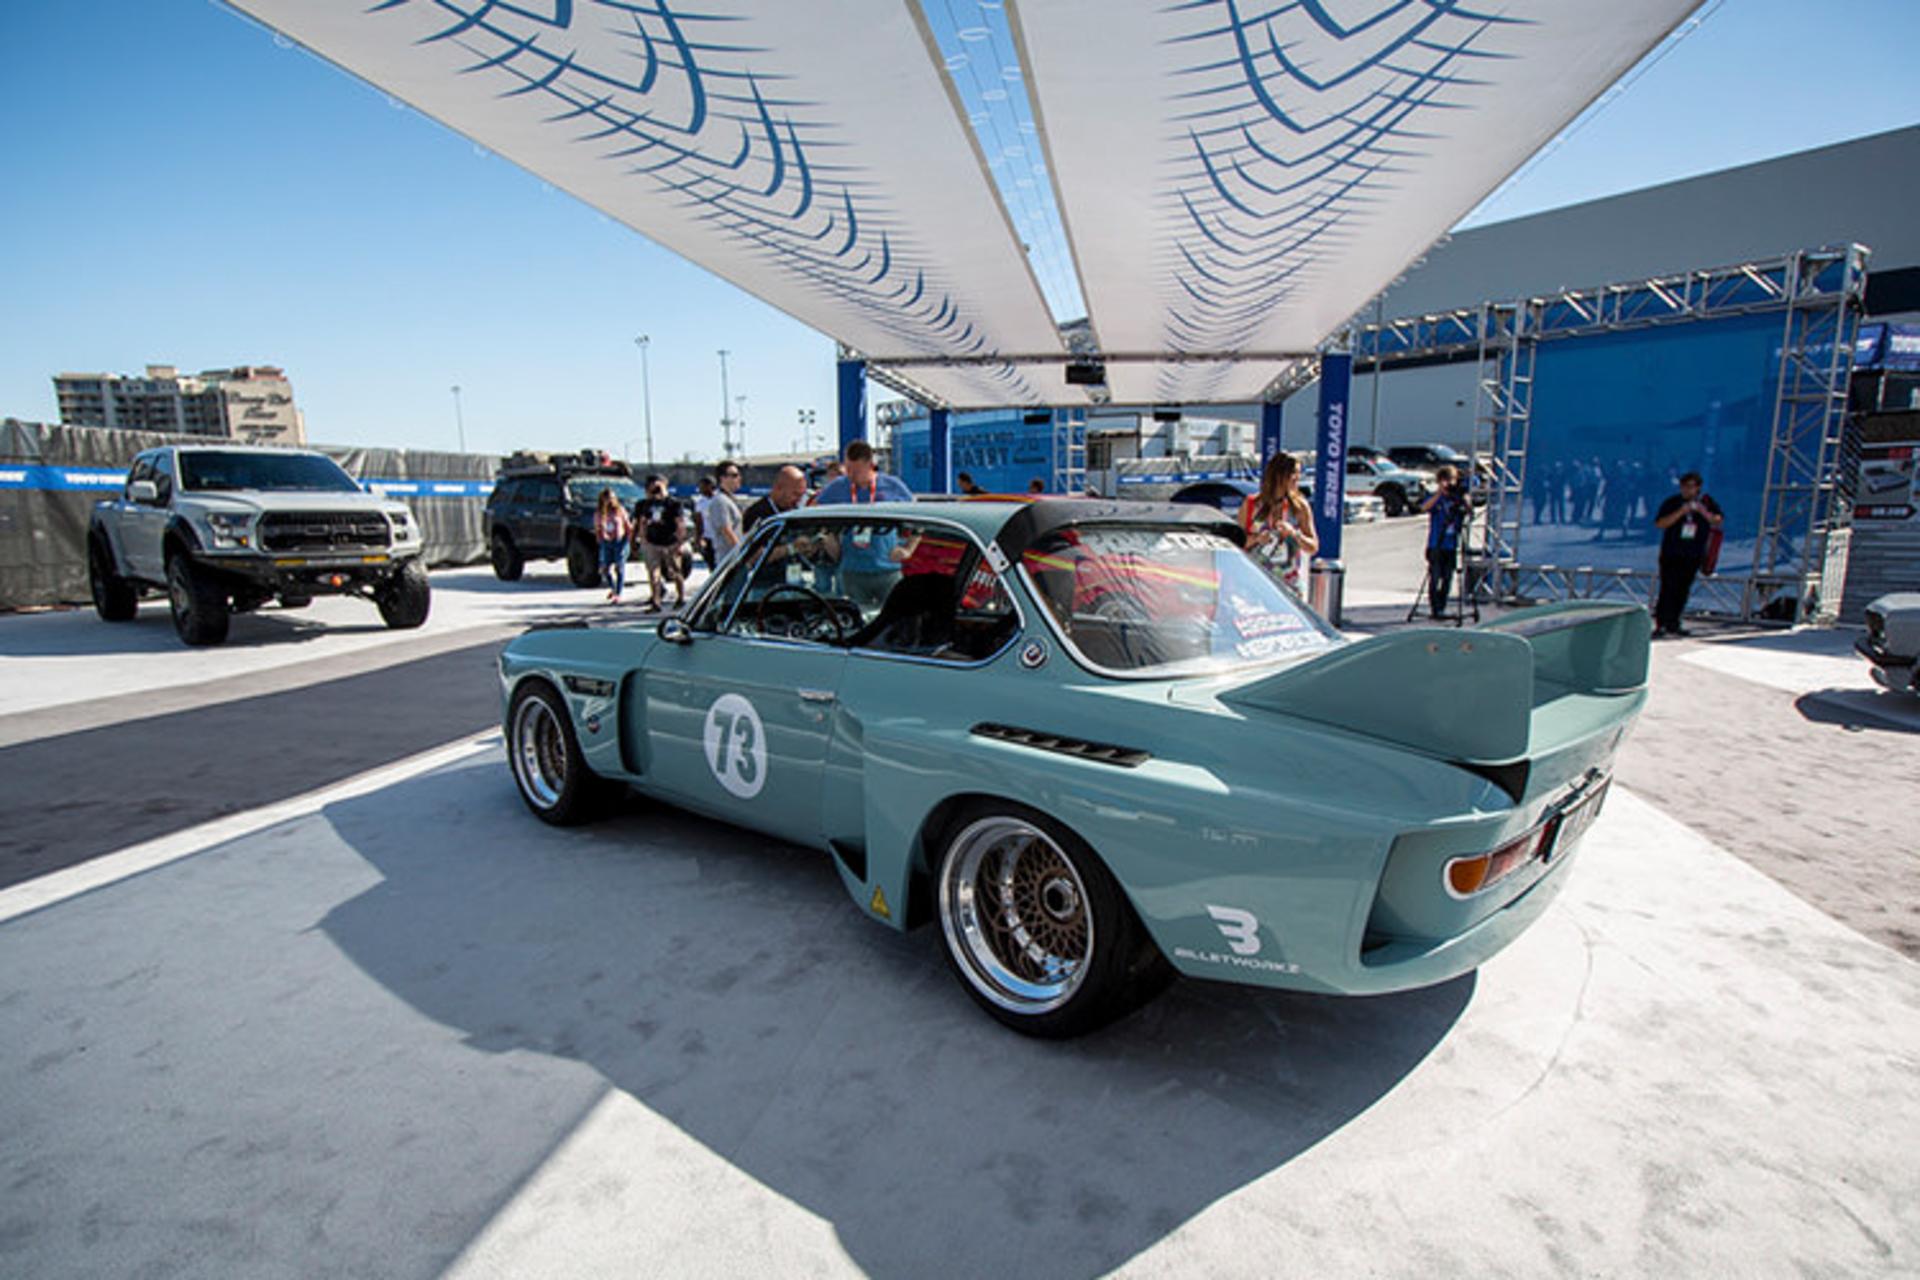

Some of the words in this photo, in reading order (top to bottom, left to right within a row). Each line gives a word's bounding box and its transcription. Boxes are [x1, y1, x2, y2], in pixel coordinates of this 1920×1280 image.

[1328, 403, 1343, 457] TOYO
[1325, 460, 1340, 519] TIRES
[714, 709, 757, 784] 73
